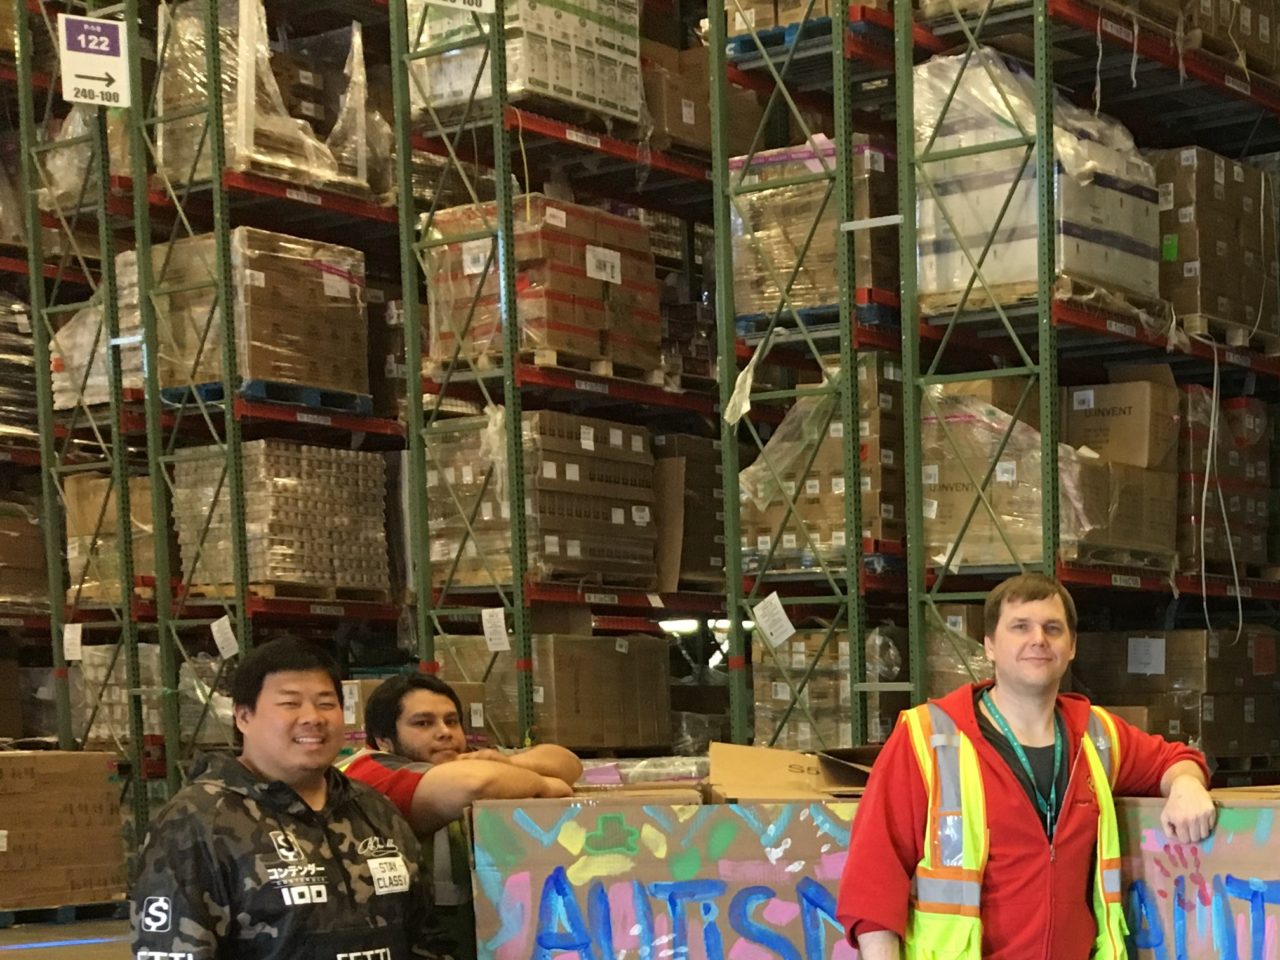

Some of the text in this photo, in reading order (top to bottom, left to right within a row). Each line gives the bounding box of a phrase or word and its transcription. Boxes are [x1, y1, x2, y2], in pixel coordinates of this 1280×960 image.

[77, 33, 110, 51] 122
[378, 861, 399, 874] STAY
[281, 884, 328, 906] 100
